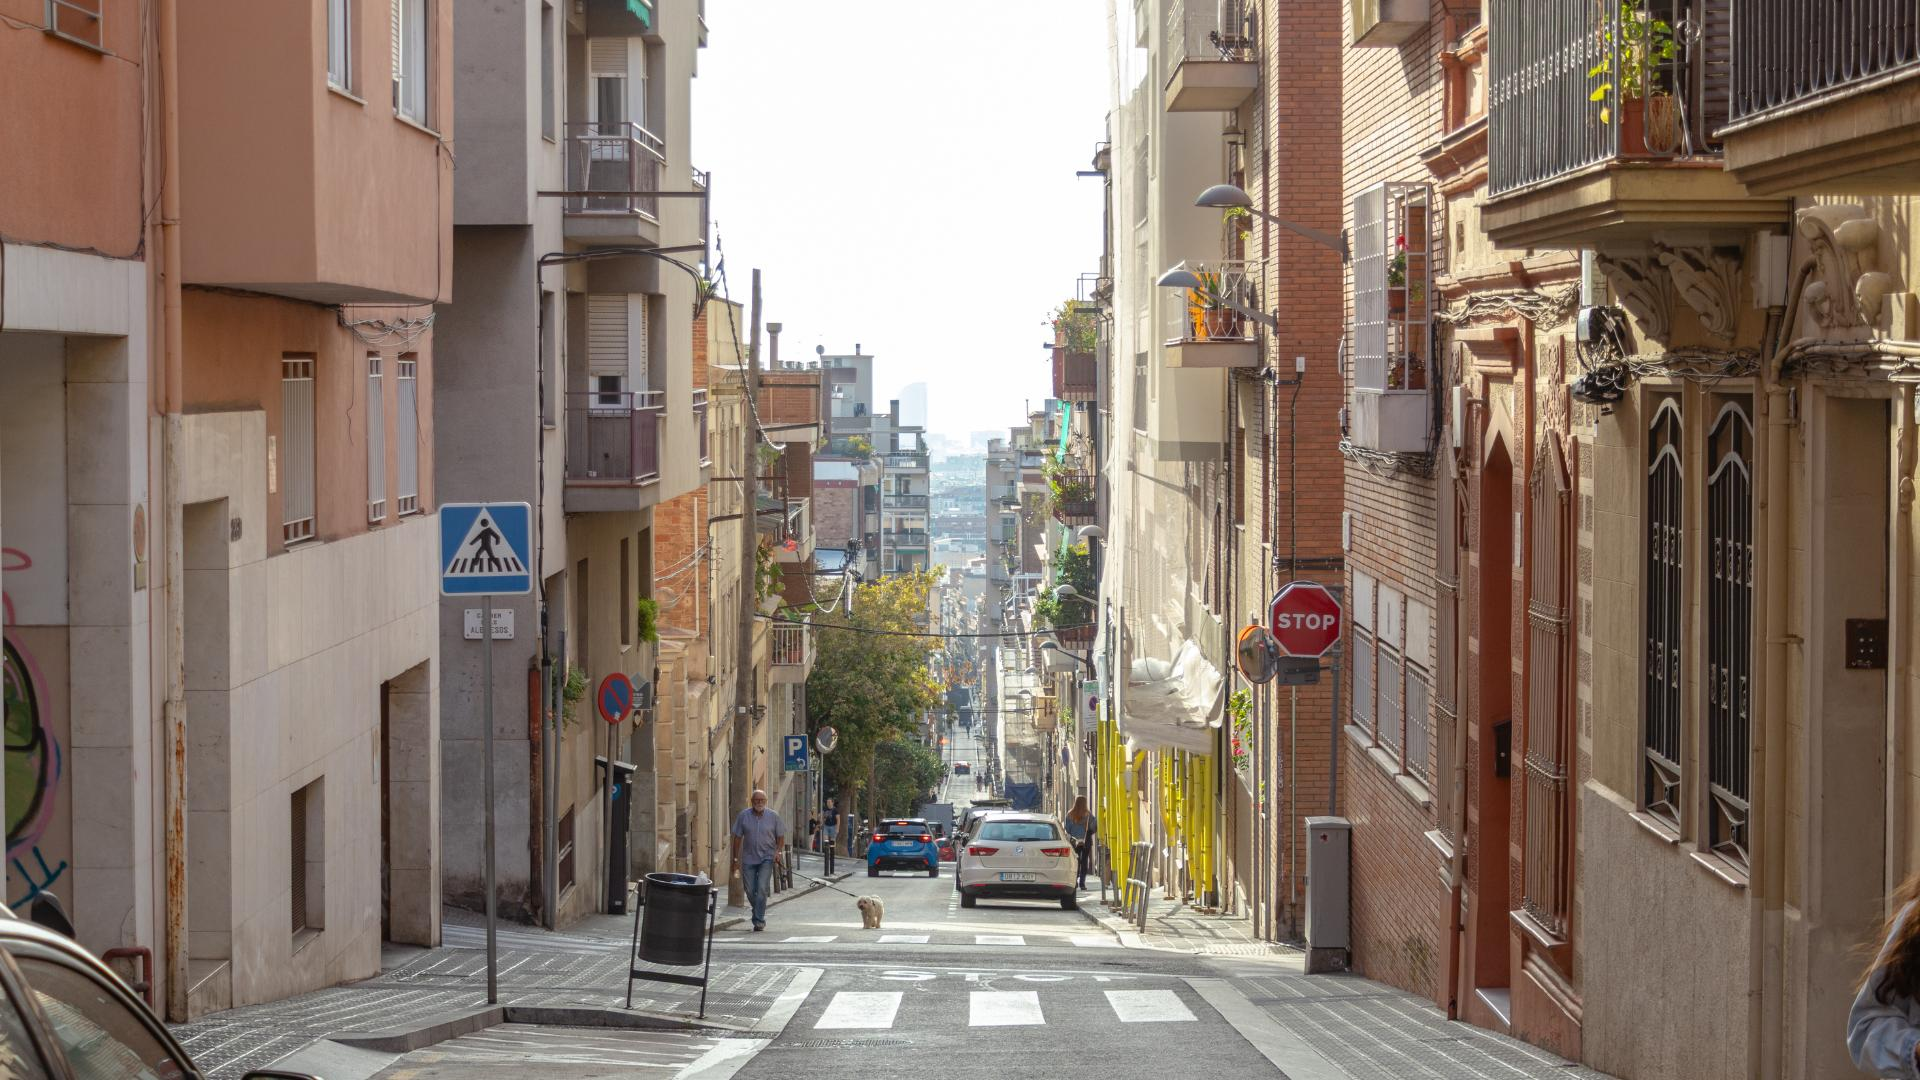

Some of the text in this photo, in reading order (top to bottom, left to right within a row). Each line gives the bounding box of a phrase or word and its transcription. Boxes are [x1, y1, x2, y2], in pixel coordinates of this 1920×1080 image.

[1278, 613, 1335, 630] STOP
[788, 738, 803, 756] P
[880, 970, 1138, 982] STOP
